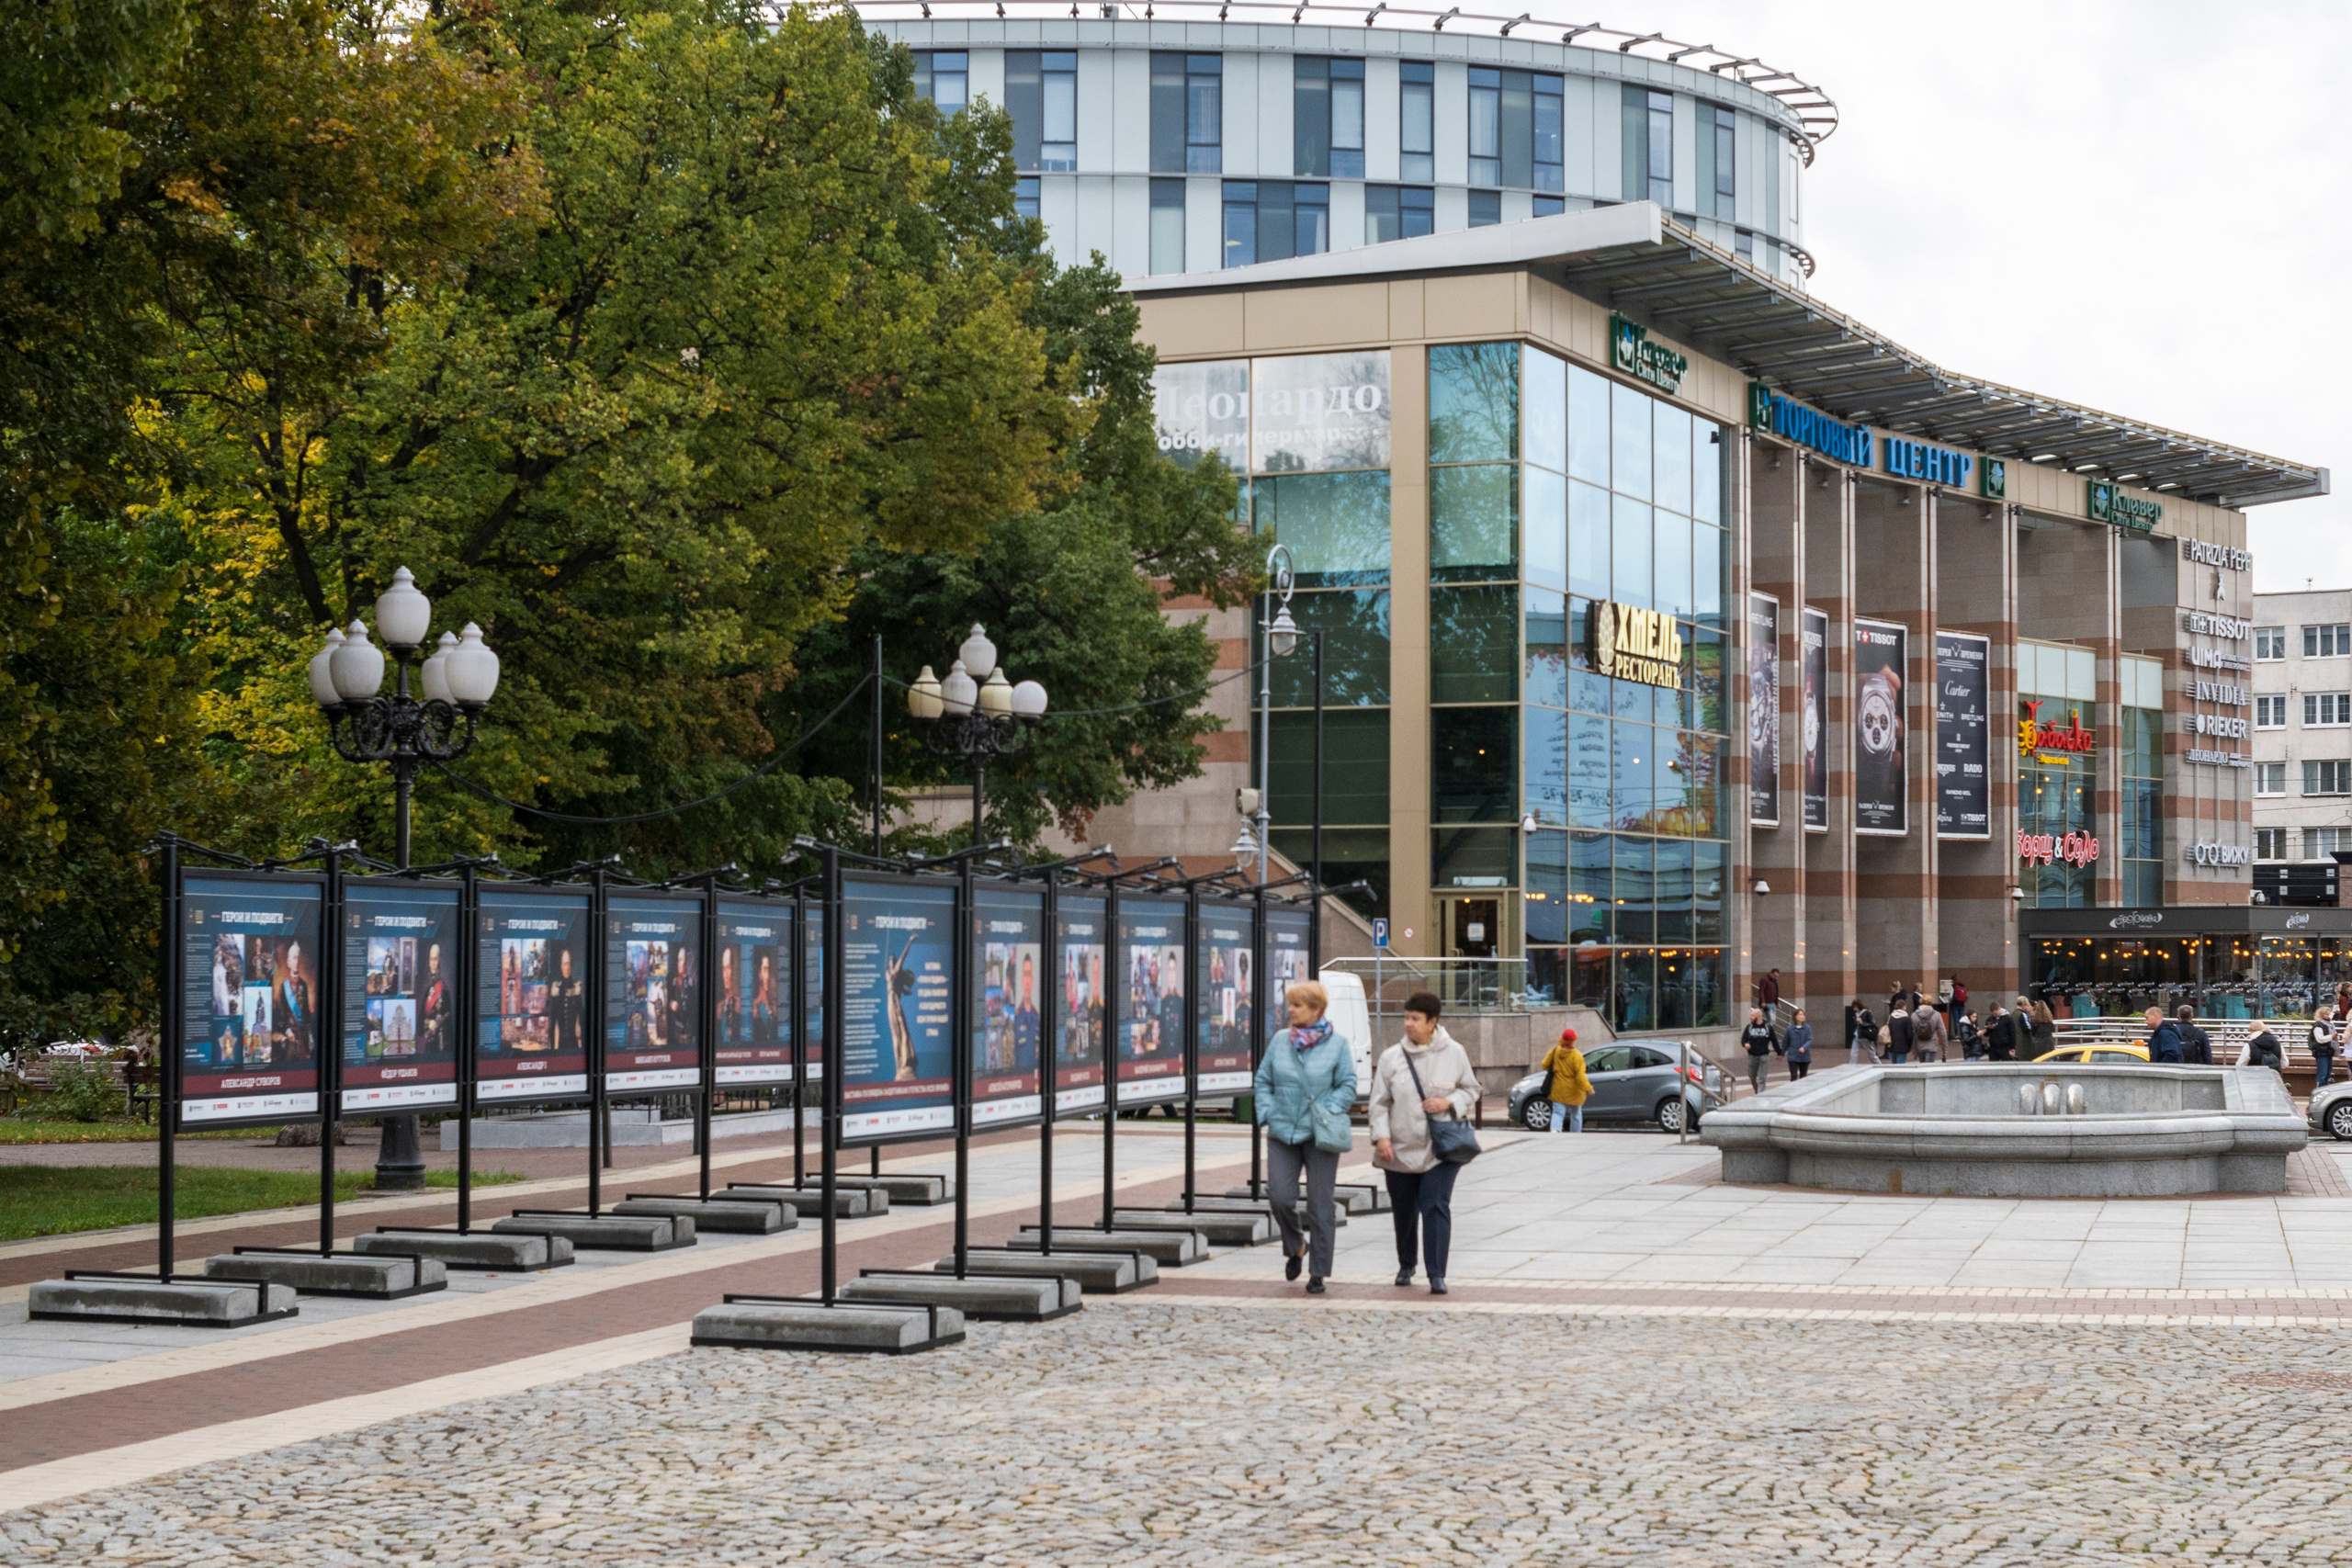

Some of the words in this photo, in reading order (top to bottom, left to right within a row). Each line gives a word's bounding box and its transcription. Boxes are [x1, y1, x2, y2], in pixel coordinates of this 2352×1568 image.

[1770, 394, 1874, 468] ТОРГОВЫЙ
[1884, 437, 1973, 487] ЦЕНТР
[2190, 537, 2228, 568] PATRIZIA
[2230, 546, 2252, 571] PEPE
[1615, 602, 1682, 663] ХМЕЛЬ
[1869, 632, 1897, 646] TISSOT
[2207, 615, 2251, 641] TISSOT
[1615, 654, 1681, 689] РЕСТОРАНЪ
[1945, 680, 1971, 697] Cartier
[2196, 681, 2246, 705] INVIDIA
[1937, 711, 1954, 719] ENITH
[2206, 715, 2247, 739] RIEKER
[1963, 763, 1983, 773] RADO
[2188, 749, 2229, 765] ЛЕОНАРДО
[2054, 836, 2064, 859] &
[2064, 829, 2099, 869] Сало
[2222, 845, 2249, 864] ВИЖУ
